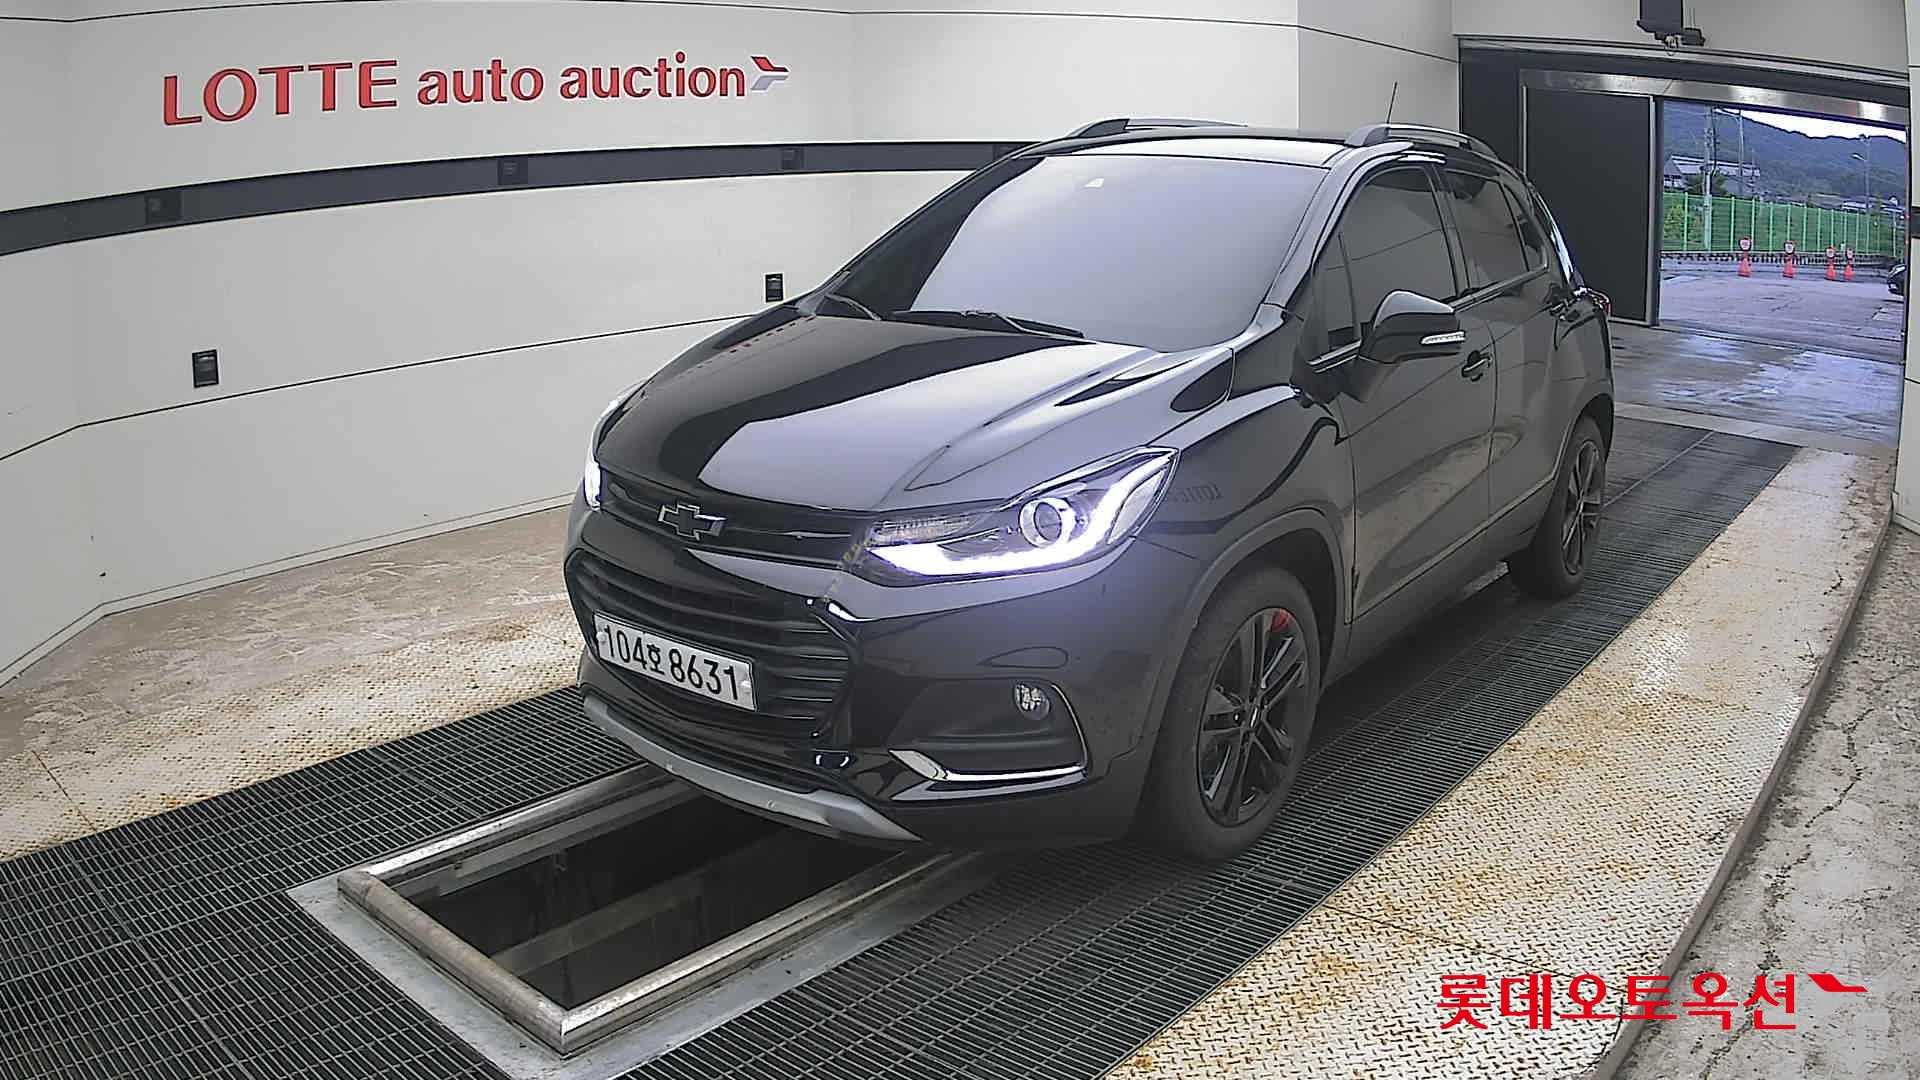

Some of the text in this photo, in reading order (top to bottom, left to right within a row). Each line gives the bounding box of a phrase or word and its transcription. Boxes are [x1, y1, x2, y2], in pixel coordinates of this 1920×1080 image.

[163, 51, 745, 126] LOTTE auto auction
[604, 624, 738, 700] 104호 8631
